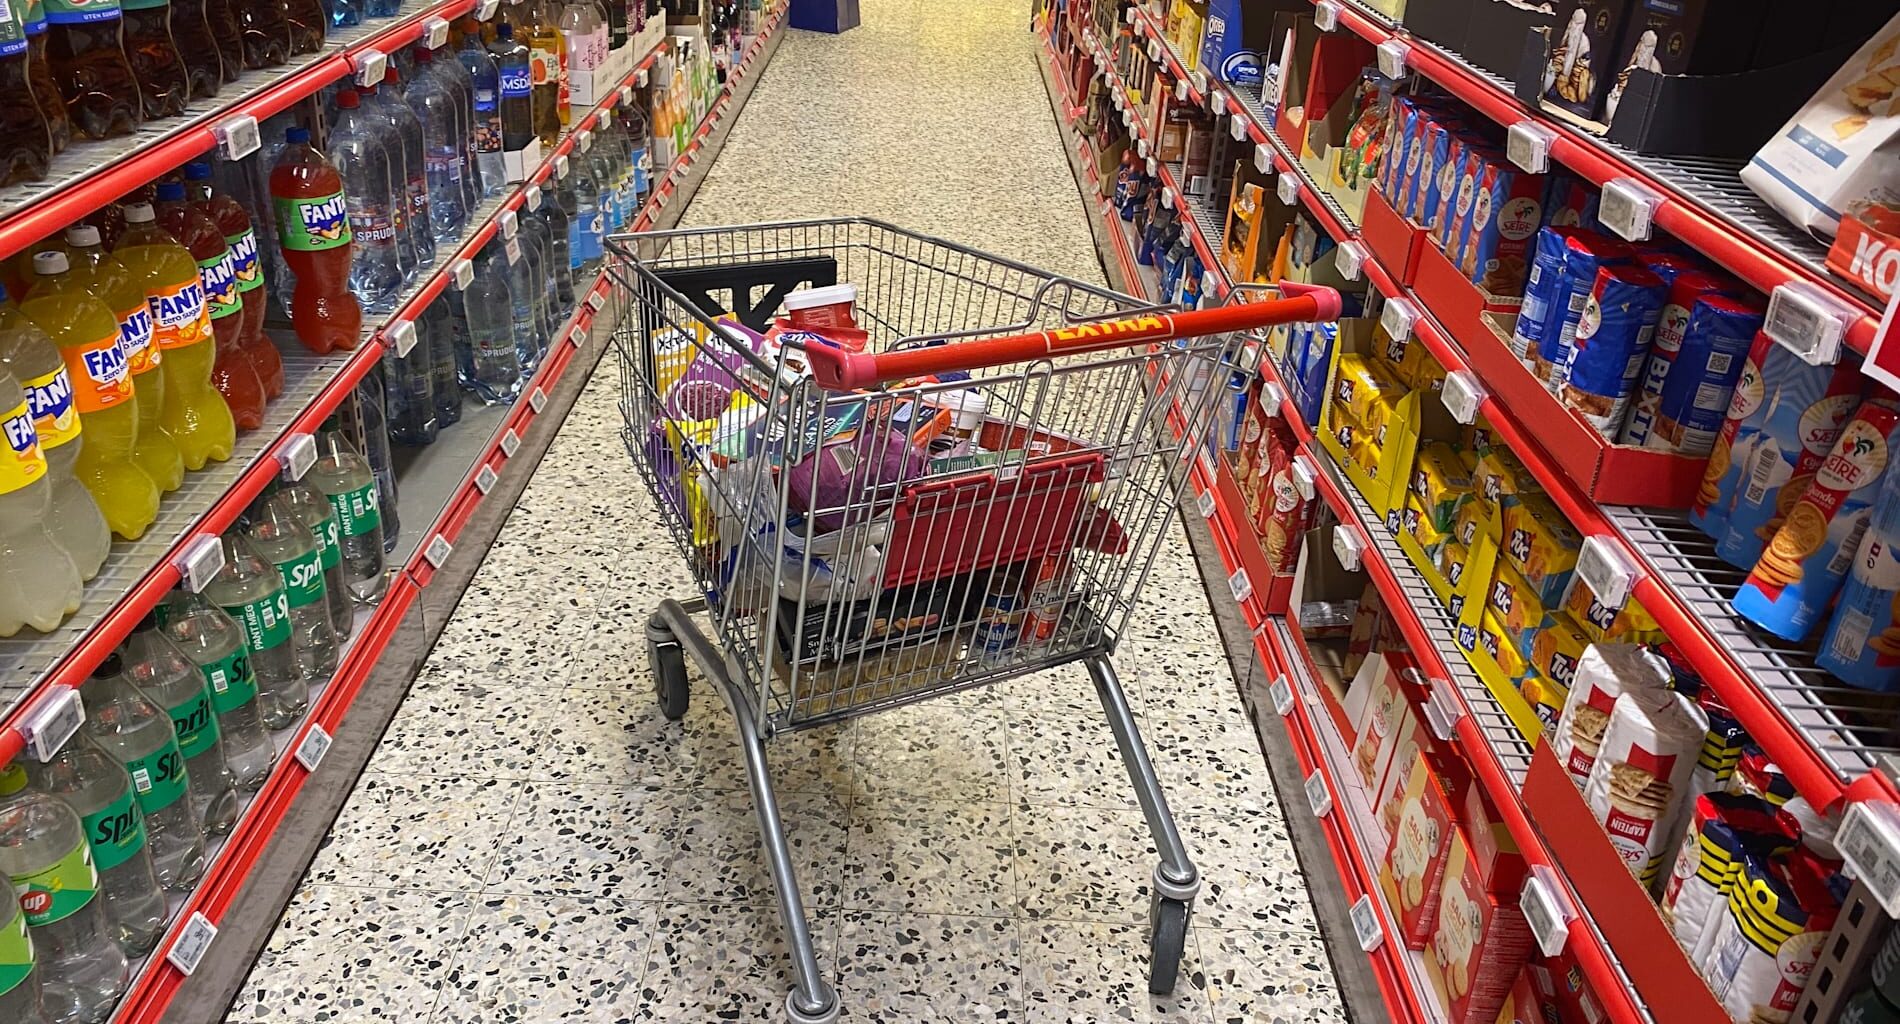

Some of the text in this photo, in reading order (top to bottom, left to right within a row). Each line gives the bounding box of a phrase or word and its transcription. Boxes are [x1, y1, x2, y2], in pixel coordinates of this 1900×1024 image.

[1208, 16, 1226, 35] OREO
[163, 315, 182, 326] zero
[1055, 316, 1164, 341] EXTRA
[1484, 475, 1501, 502] TUC
[341, 515, 353, 536] PANT
[1387, 511, 1400, 534] TUC
[1510, 530, 1530, 562] TUC
[1493, 581, 1512, 614] TUC
[250, 627, 264, 651] PANT
[1458, 626, 1475, 650] TUC
[1550, 653, 1574, 688] TUC
[1611, 817, 1647, 838] KAPTEIN
